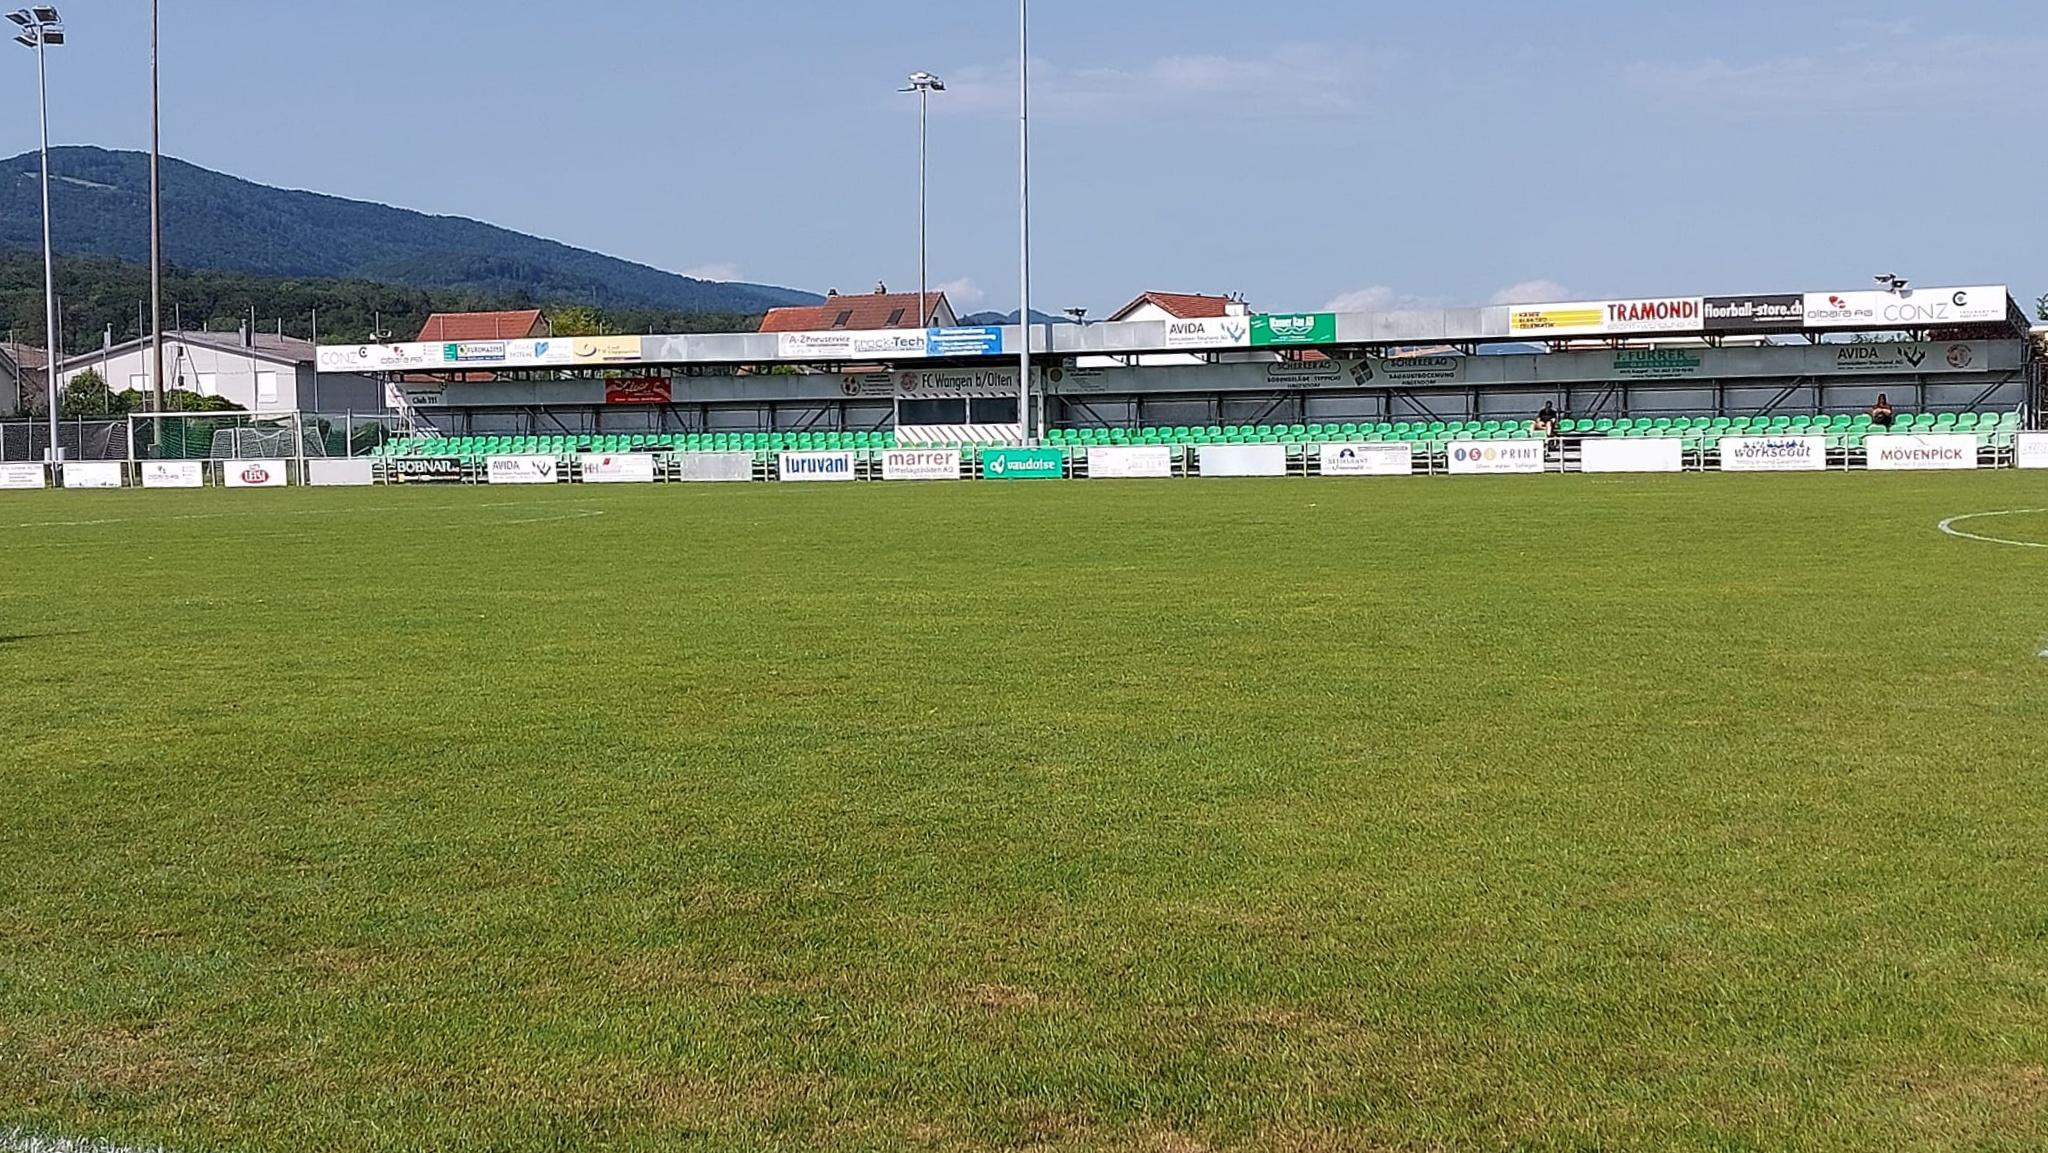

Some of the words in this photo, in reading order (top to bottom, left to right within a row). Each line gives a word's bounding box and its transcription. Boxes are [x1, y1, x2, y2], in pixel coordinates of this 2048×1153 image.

[1607, 301, 1698, 321] TRAMONDI
[1883, 302, 1949, 321] CONZ
[1169, 323, 1205, 334] AVIDA
[320, 351, 358, 365] CONZ
[1628, 349, 1687, 361] FURRER
[1837, 347, 1879, 360] AVIDA
[922, 373, 934, 389] FC
[935, 372, 973, 391] Wangen
[975, 371, 1013, 388] b/Olten
[1501, 448, 1538, 460] PRINT
[1734, 446, 1811, 458] workscout
[1880, 448, 1963, 461] MÖVENPICK
[492, 460, 520, 470] AVIDA
[785, 454, 849, 473] turuvani
[888, 452, 953, 466] marrer
[1007, 460, 1056, 471] vaudoise
